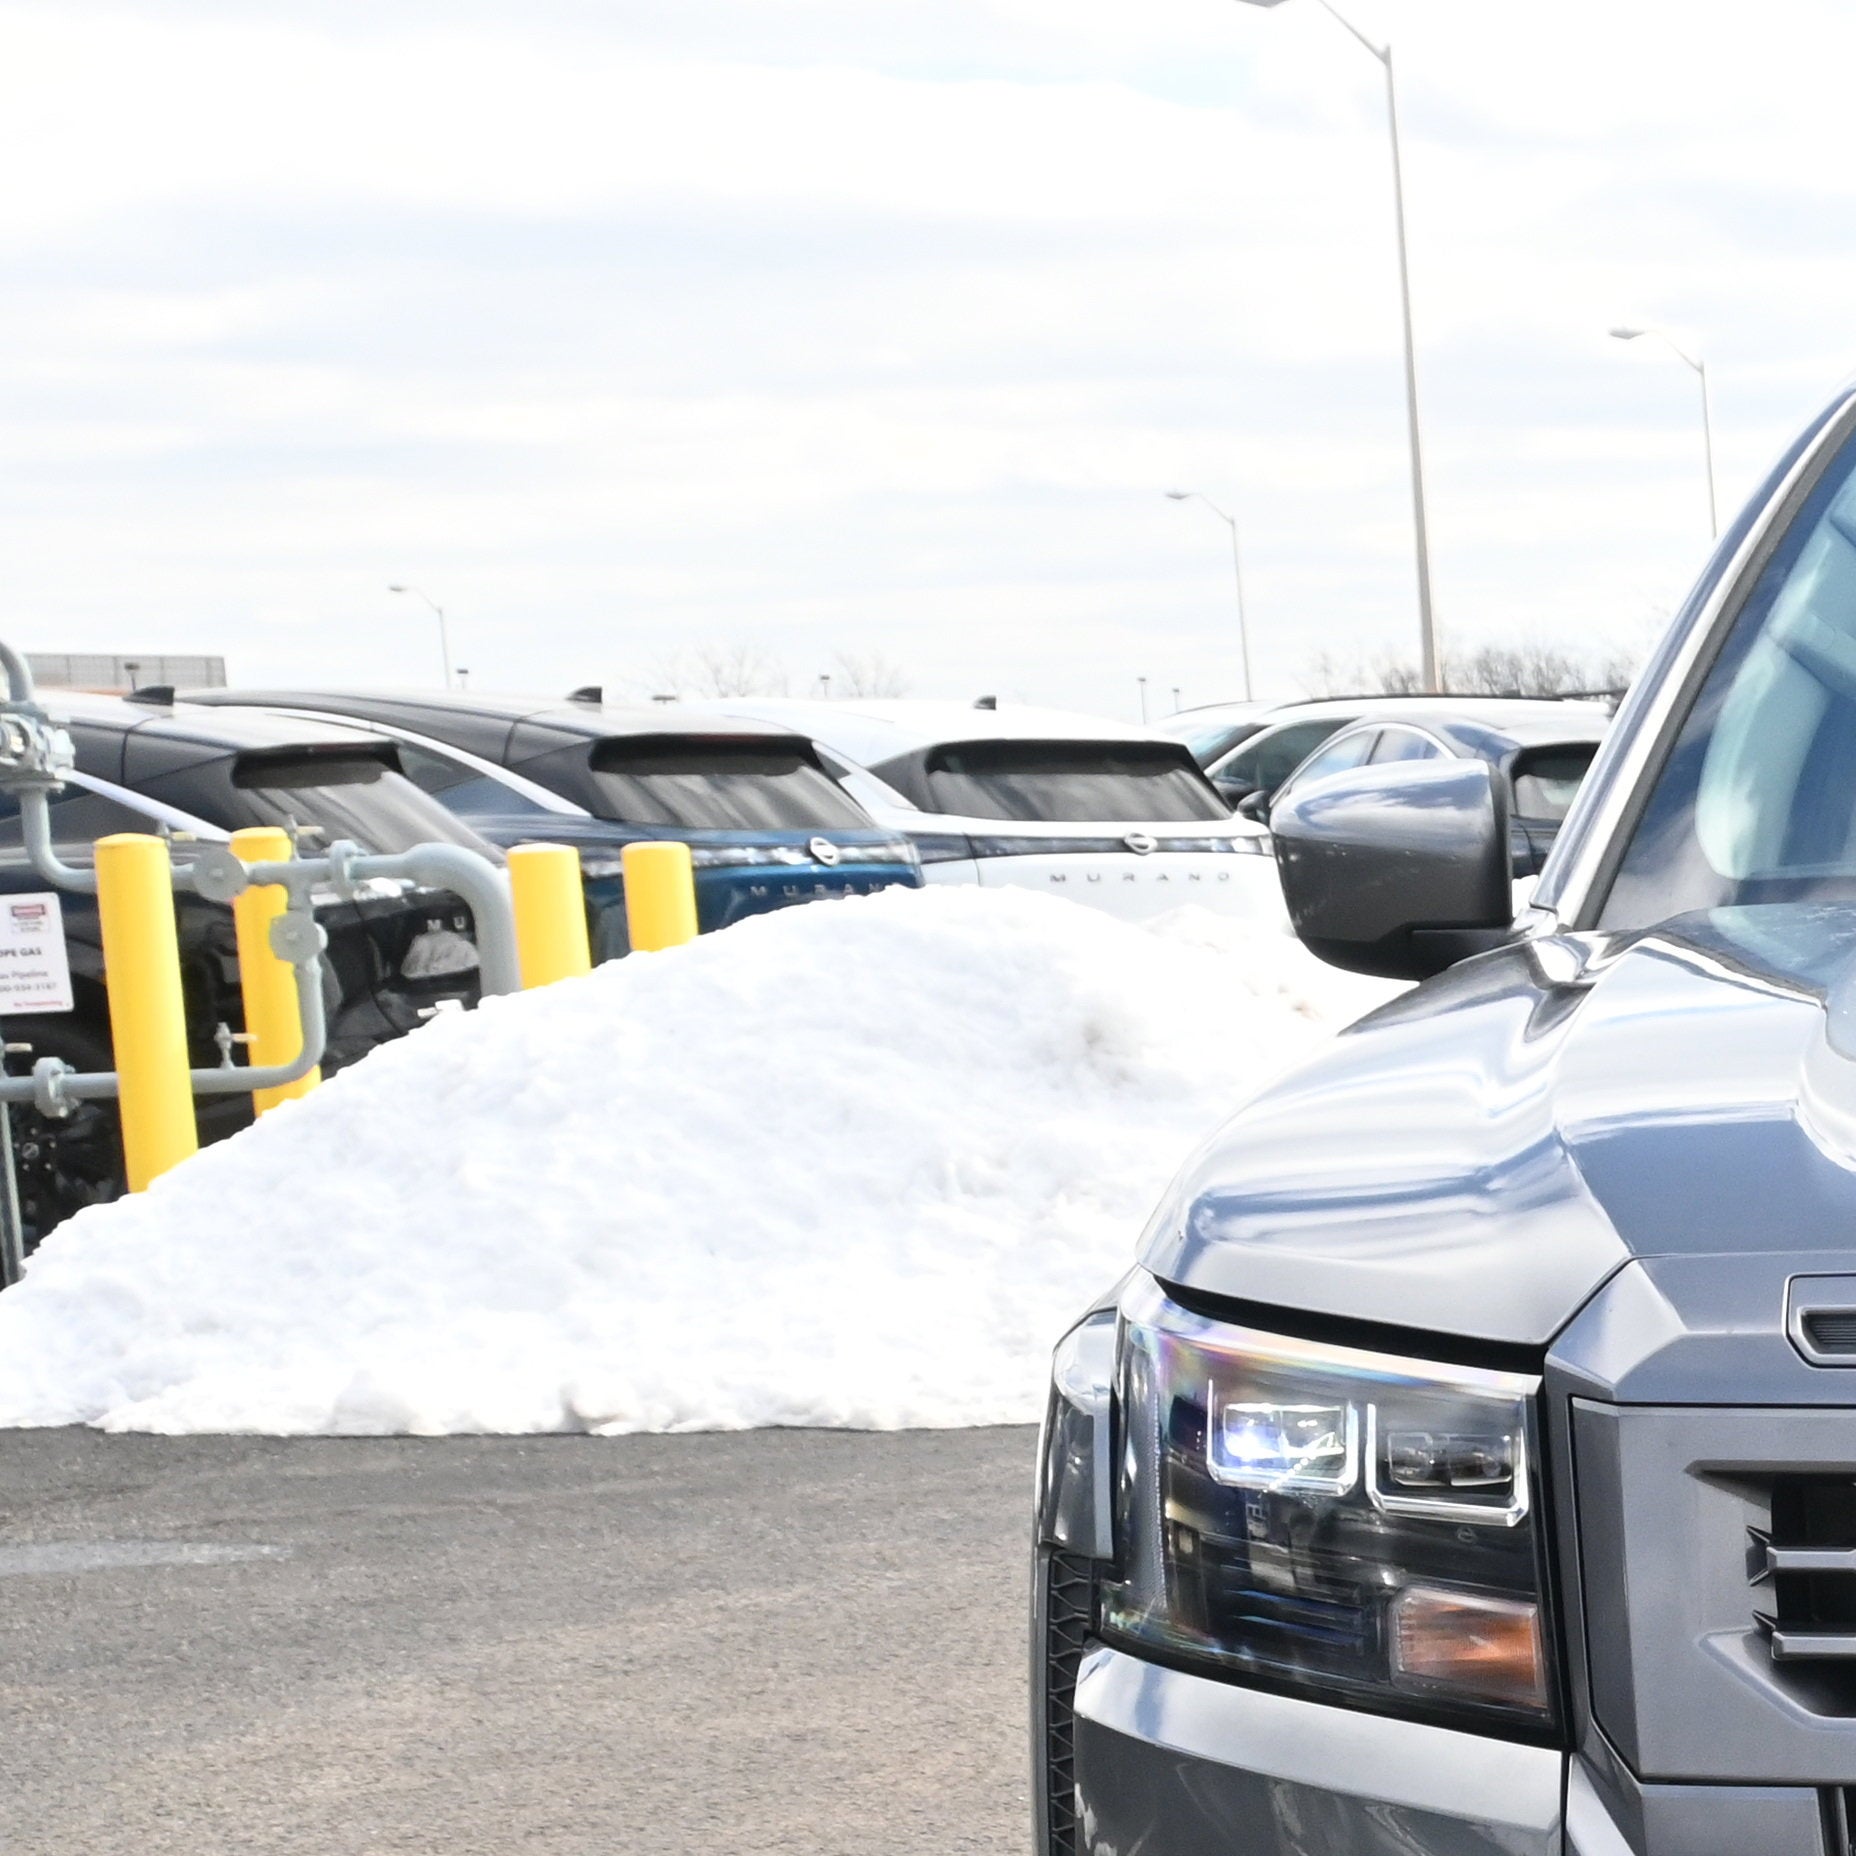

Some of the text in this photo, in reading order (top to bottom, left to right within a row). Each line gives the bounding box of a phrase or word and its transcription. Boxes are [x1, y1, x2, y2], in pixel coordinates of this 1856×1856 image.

[1050, 872, 1230, 883] MURANO
[750, 883, 882, 896] MURAN
[20, 946, 42, 956] GAS
